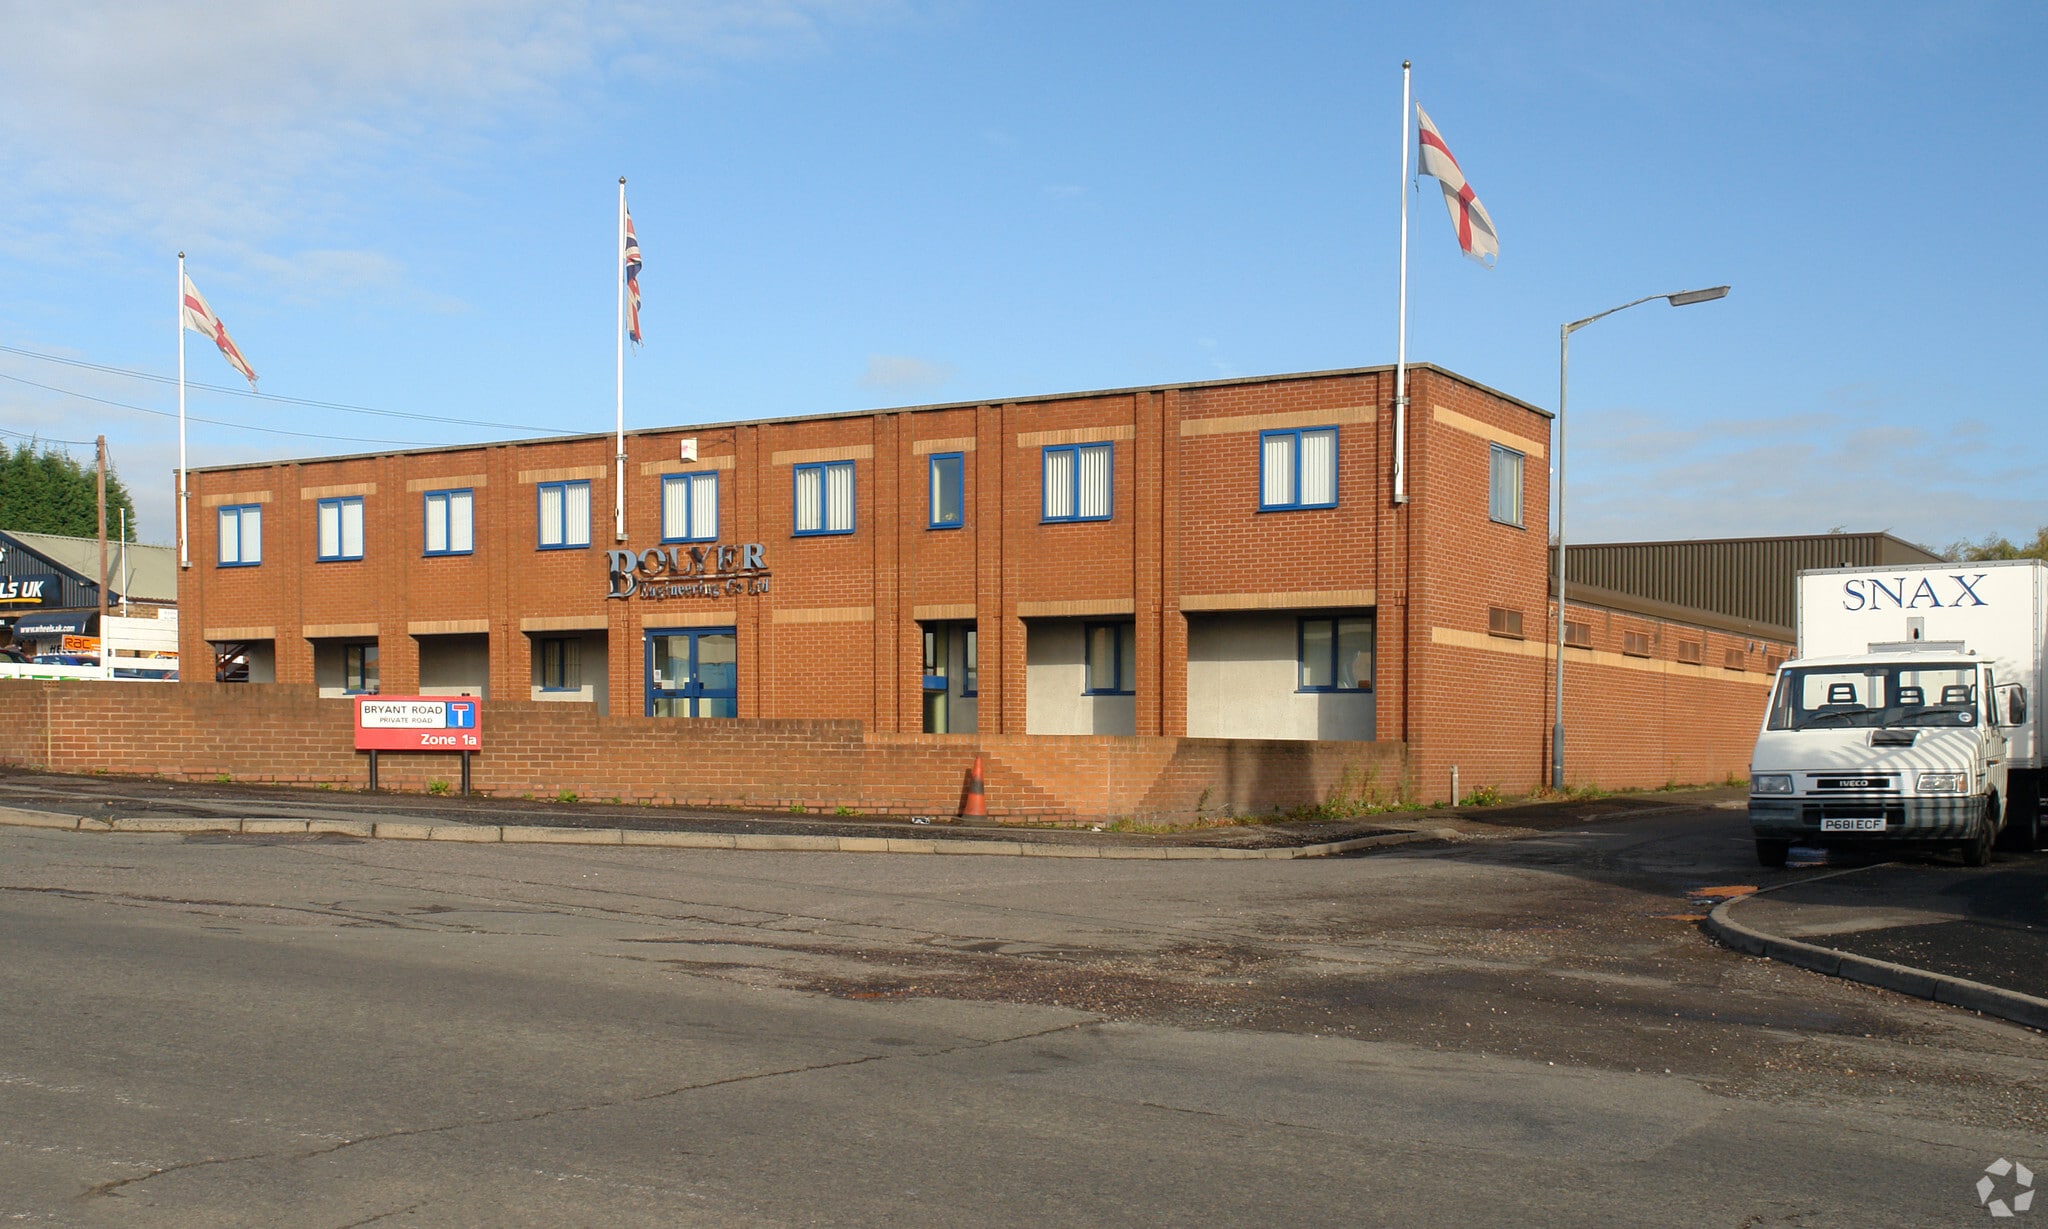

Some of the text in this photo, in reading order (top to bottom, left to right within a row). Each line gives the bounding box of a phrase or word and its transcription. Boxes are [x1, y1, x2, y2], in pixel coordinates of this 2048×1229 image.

[606, 543, 768, 598] BOLYER
[22, 581, 44, 597] UK
[640, 578, 769, 600] Engineering Co Ltd
[1842, 574, 1989, 611] SNAX
[364, 705, 443, 714] BRYANT ROAD
[421, 734, 477, 745] Zone 1a
[1825, 820, 1881, 829] P681 ECF
